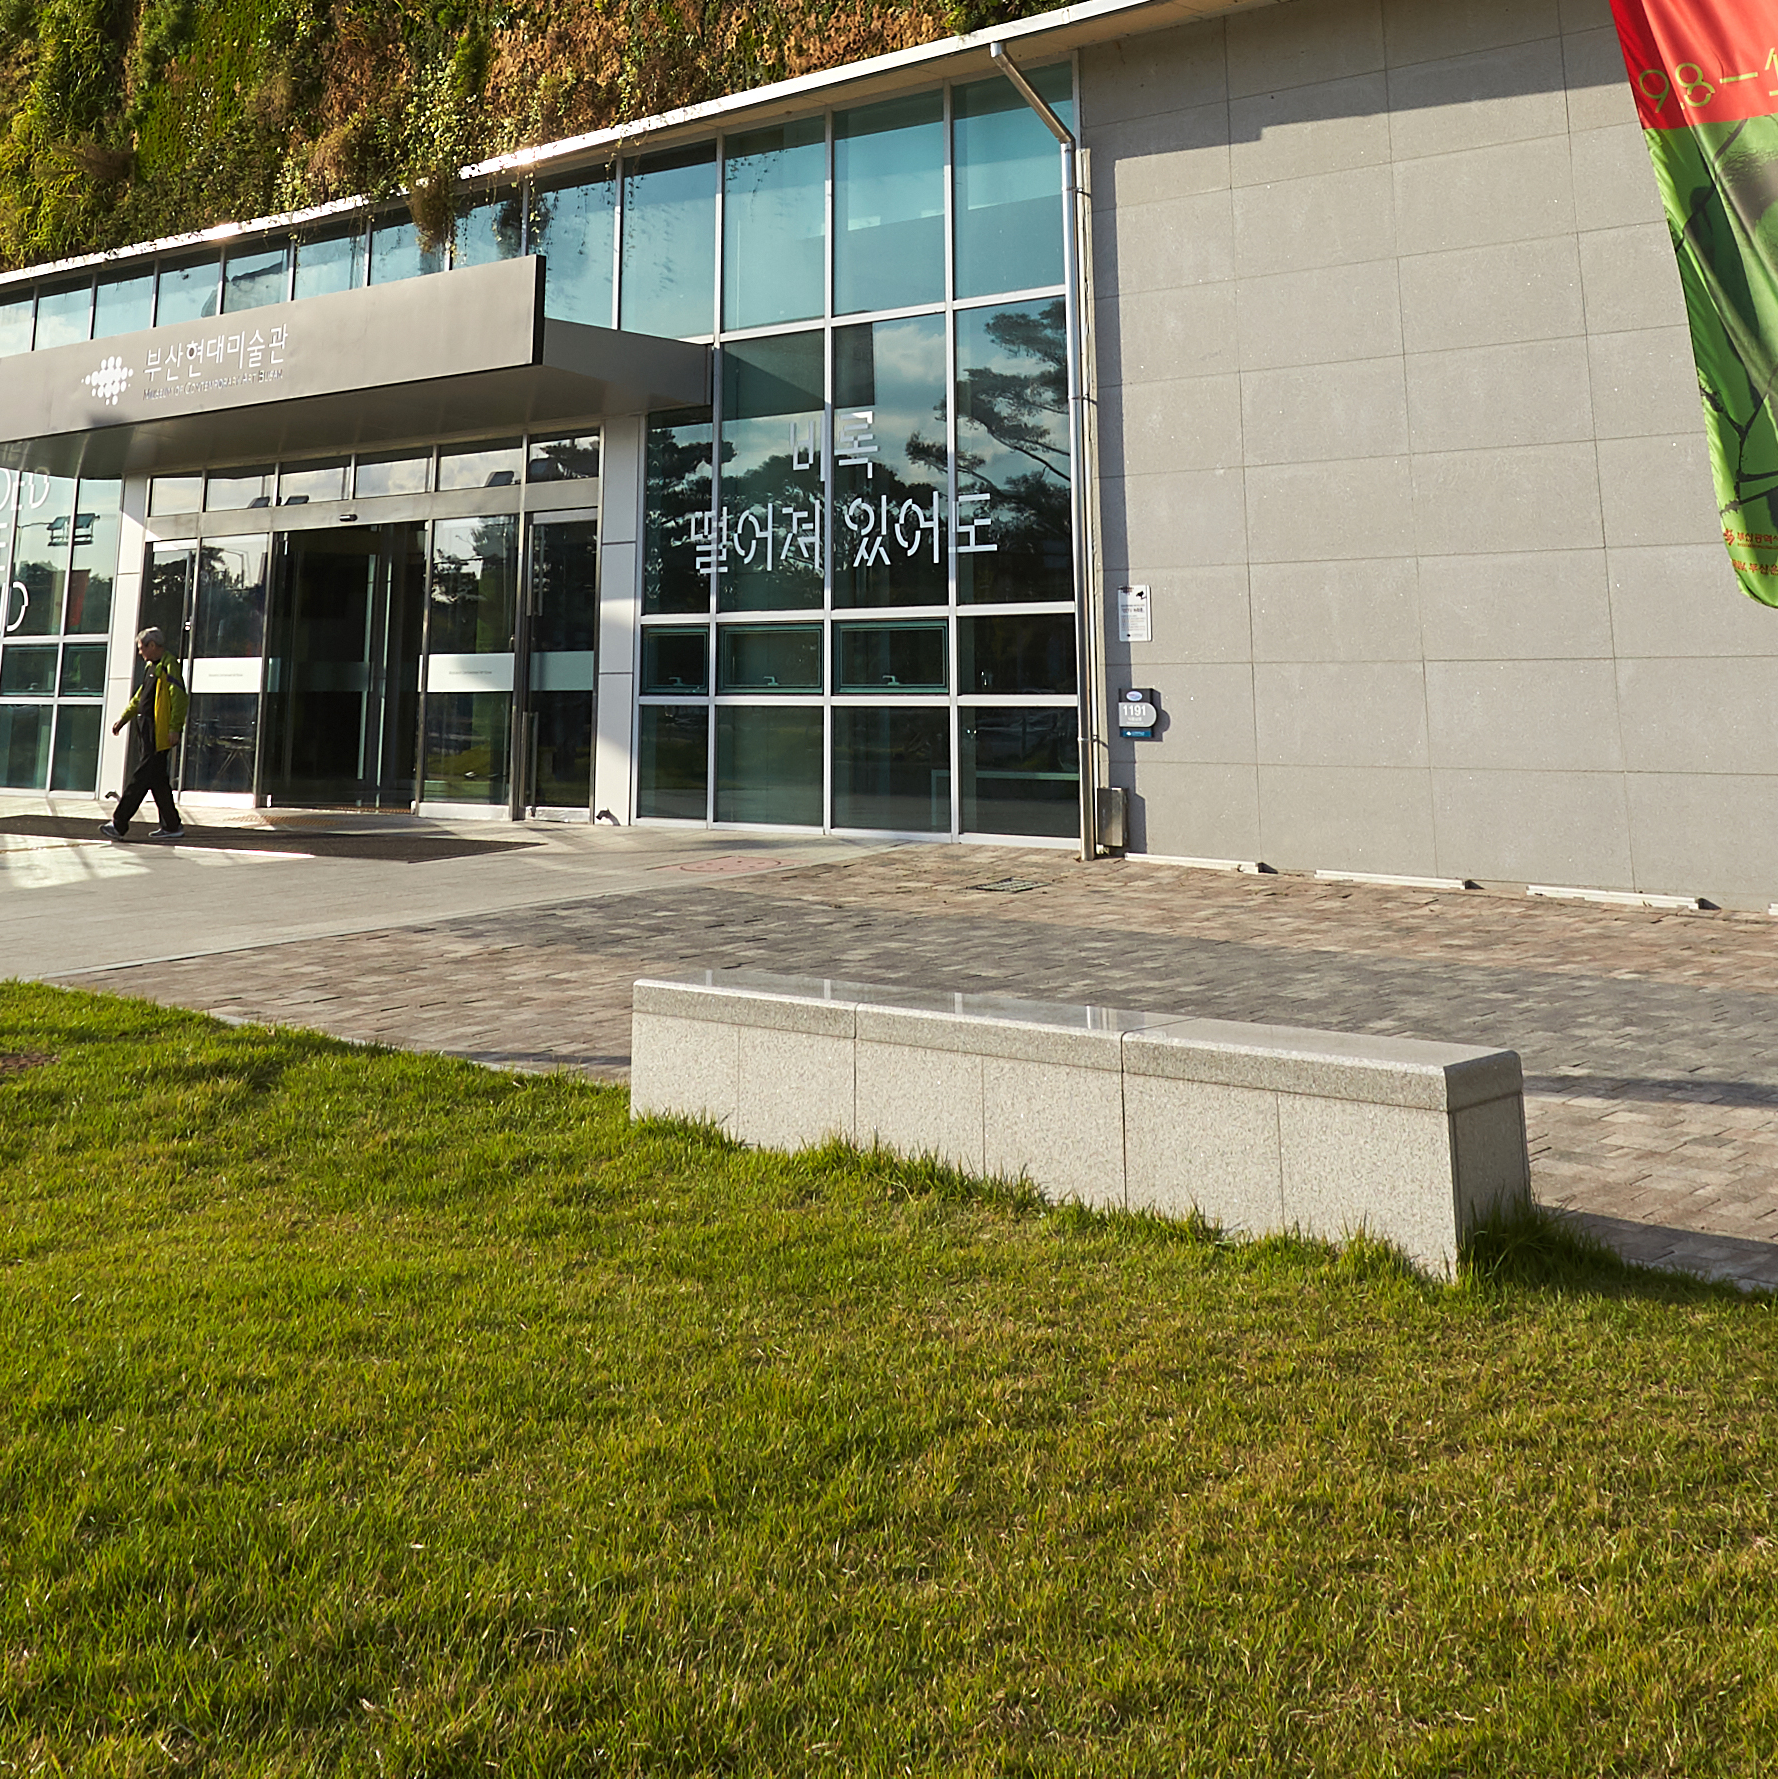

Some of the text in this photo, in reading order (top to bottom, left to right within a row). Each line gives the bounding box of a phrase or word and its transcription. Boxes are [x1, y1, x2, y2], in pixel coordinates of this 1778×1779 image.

[143, 323, 289, 382] 부산현대미술관
[690, 489, 998, 573] 떨어져 있어도
[1122, 704, 1147, 717] 1191
